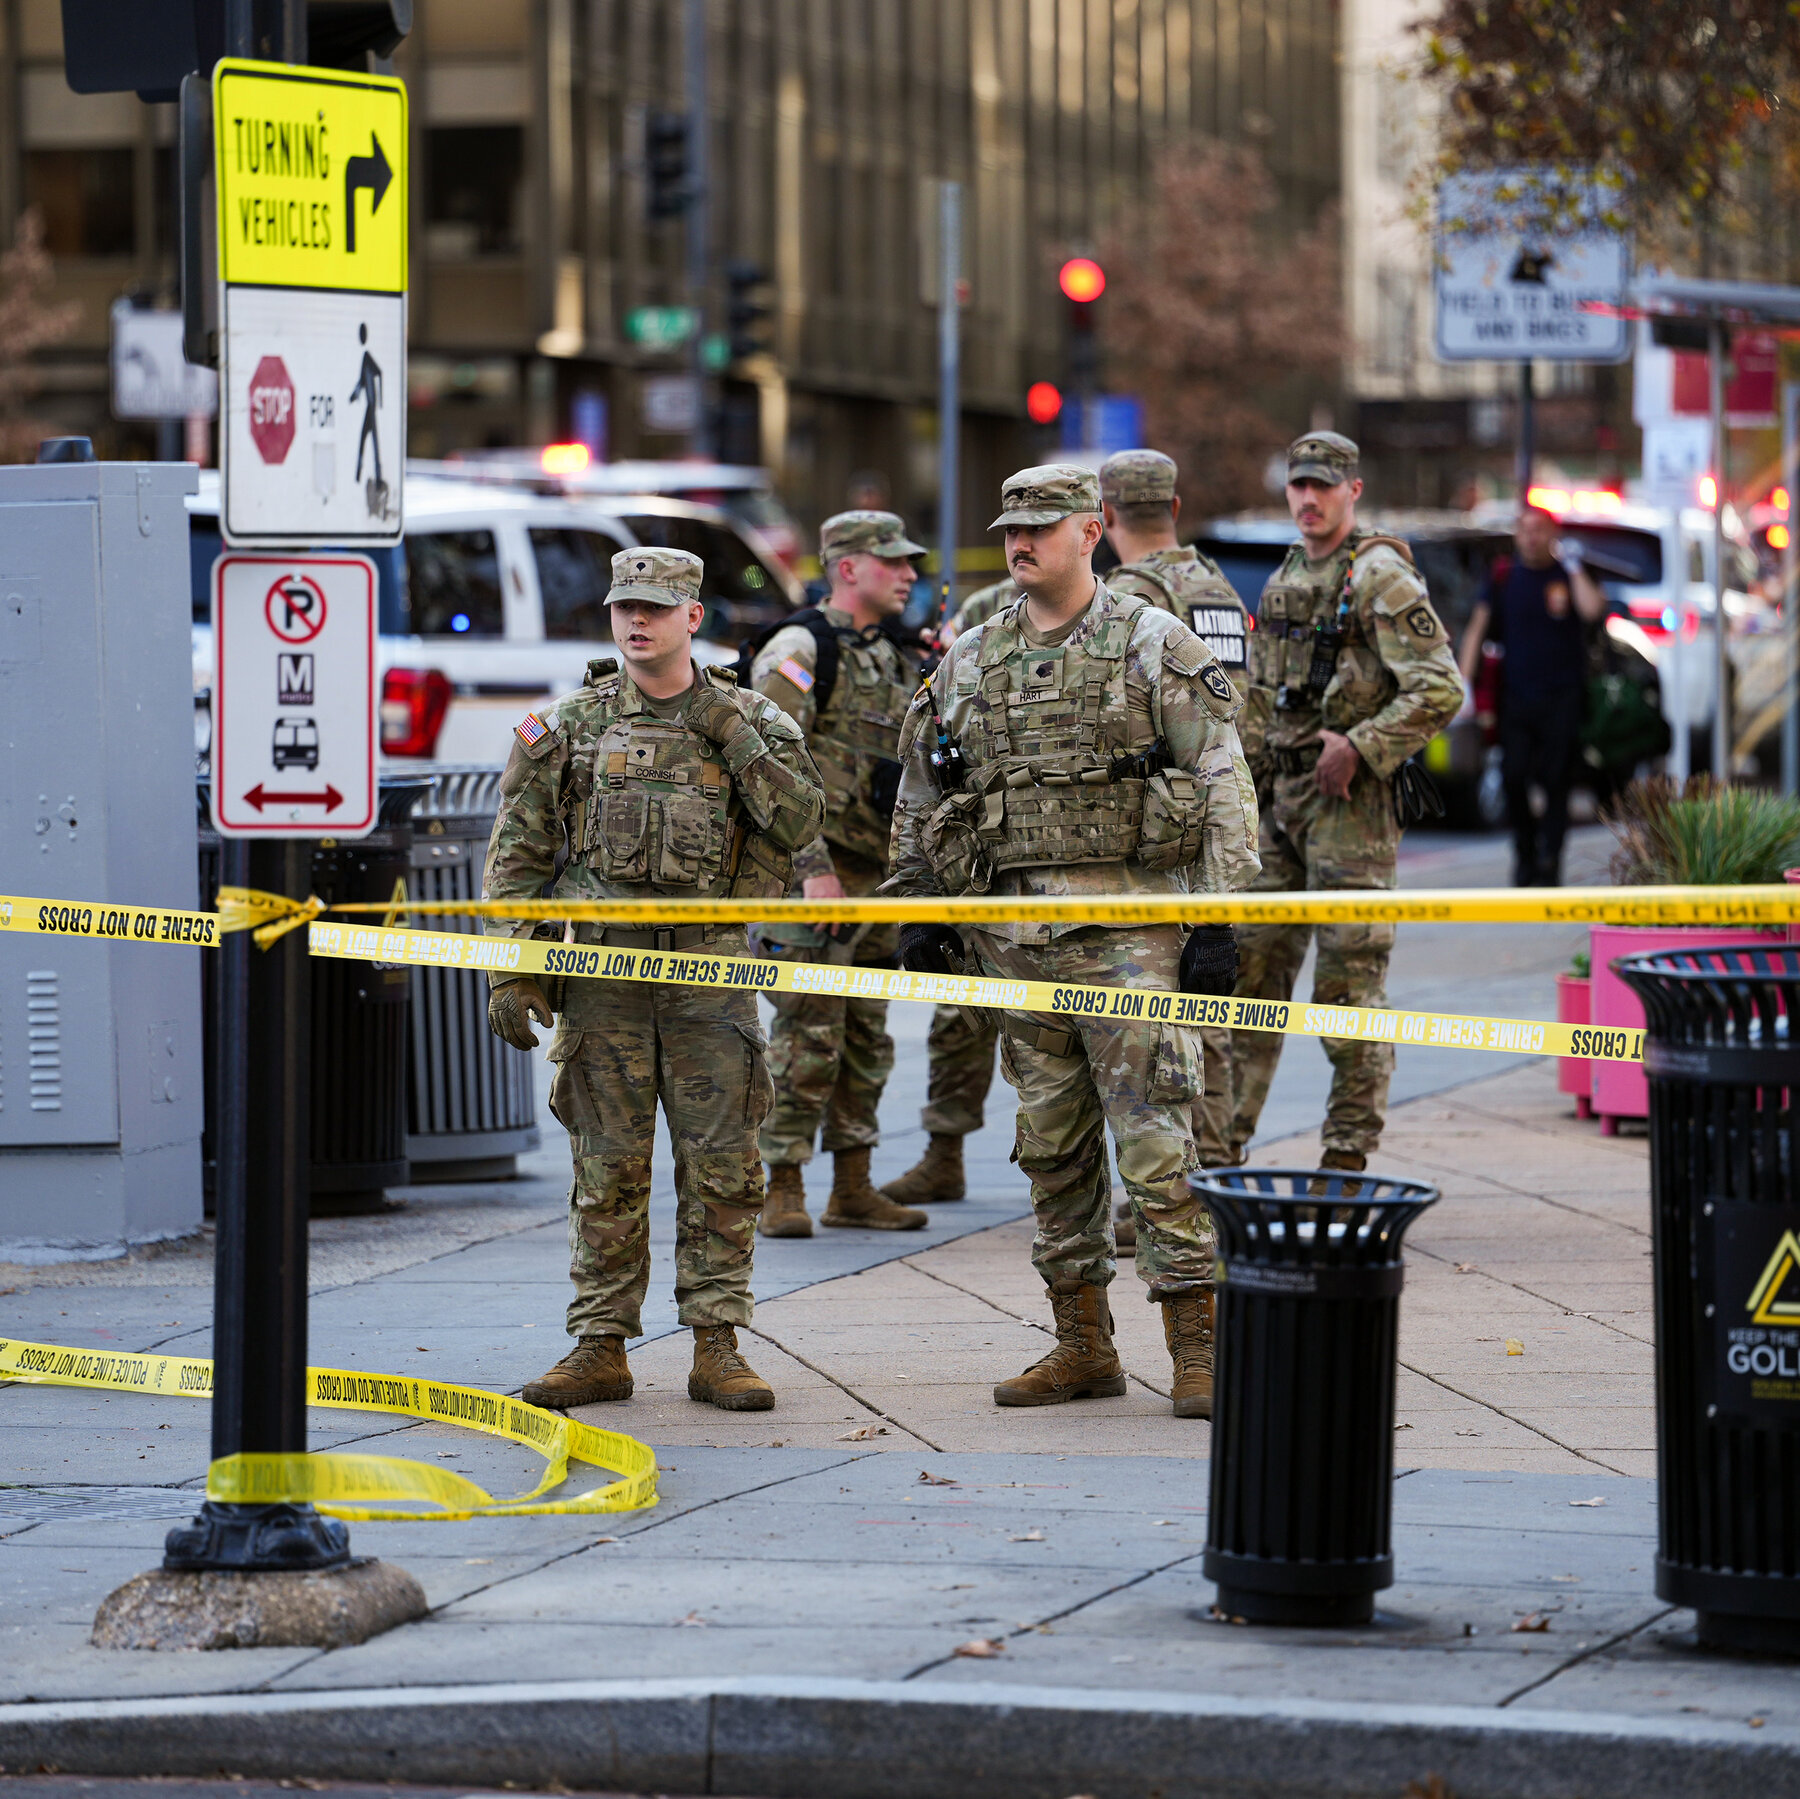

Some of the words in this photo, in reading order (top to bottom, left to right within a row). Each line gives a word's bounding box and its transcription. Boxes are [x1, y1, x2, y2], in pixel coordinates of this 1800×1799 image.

[234, 119, 329, 180] TURNING
[239, 198, 331, 250] VEHICLES
[252, 387, 292, 426] STOP
[310, 395, 335, 428] FOR
[1193, 609, 1245, 636] NATIONAL
[1205, 636, 1244, 662] GUARD
[280, 655, 313, 692] M
[1020, 690, 1042, 702] HART
[635, 768, 676, 780] CORNISH
[38, 905, 92, 934] CROSS
[97, 910, 129, 937] NOT
[133, 913, 156, 939] DO
[161, 915, 215, 943] SCENE
[308, 927, 341, 955] CRO
[343, 930, 379, 957] NOT
[382, 933, 406, 958] DO
[409, 936, 463, 964] SCENE
[466, 940, 521, 968] CRIME
[544, 948, 599, 975] CROSS
[602, 953, 637, 977] NOT
[639, 956, 663, 979] DO
[666, 958, 721, 984] SCENE
[724, 963, 779, 987] CRIME
[791, 967, 847, 992] CROSS
[849, 972, 884, 996] NOT
[887, 974, 912, 997] DO
[914, 976, 970, 1002] SCENE
[973, 981, 1028, 1006] CRIME
[1052, 988, 1107, 1014] CROSS
[1109, 993, 1144, 1017] NOT
[1149, 996, 1172, 1019] DO
[1175, 998, 1230, 1024] SCENE
[1234, 1002, 1289, 1029] CRIME
[1304, 1008, 1359, 1036] CROSS
[1362, 1013, 1397, 1038] NOT
[1402, 1016, 1425, 1041] DO
[1429, 1019, 1484, 1046] SCENE
[1489, 1024, 1545, 1050] CRIME
[1571, 1030, 1627, 1059] CROSS
[1769, 1330, 1799, 1348] THE
[16, 1348, 55, 1373] CROSS
[51, 1353, 77, 1376] NOT
[74, 1355, 93, 1378] DO
[90, 1357, 115, 1381] LINE
[113, 1359, 149, 1385] POLICE
[1727, 1343, 1800, 1377] GOL
[179, 1364, 209, 1392] CROSS
[317, 1374, 342, 1400] CROSS
[343, 1377, 357, 1402] NOT
[358, 1378, 369, 1403] DO
[369, 1379, 386, 1405] LINE
[386, 1381, 410, 1407] POLICE
[428, 1387, 448, 1415] CROSS
[449, 1391, 460, 1417] NOT
[460, 1393, 468, 1419] DO
[468, 1394, 480, 1422] LINE
[480, 1397, 497, 1426] POLICE
